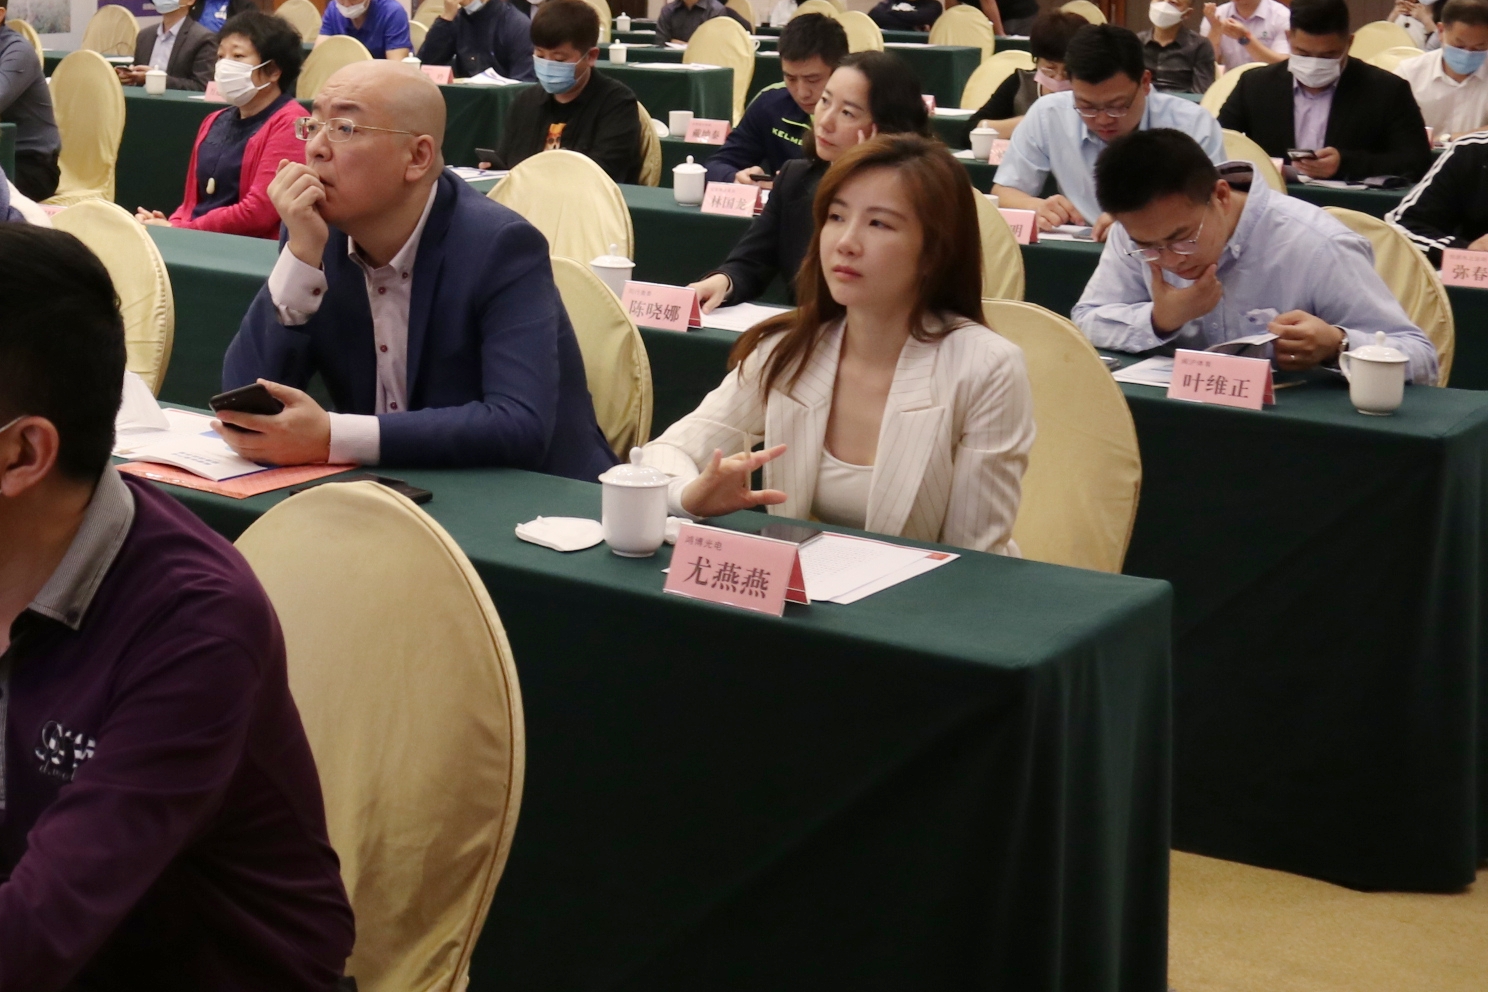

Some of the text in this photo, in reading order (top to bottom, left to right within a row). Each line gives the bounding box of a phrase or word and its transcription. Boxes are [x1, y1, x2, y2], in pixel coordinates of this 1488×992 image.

[711, 194, 748, 211] 林国龙
[628, 299, 682, 323] 陈晓娜
[1182, 372, 1251, 399] 叶维正
[684, 534, 723, 551] 鸿博光电
[682, 555, 771, 600] 尤燕燕
